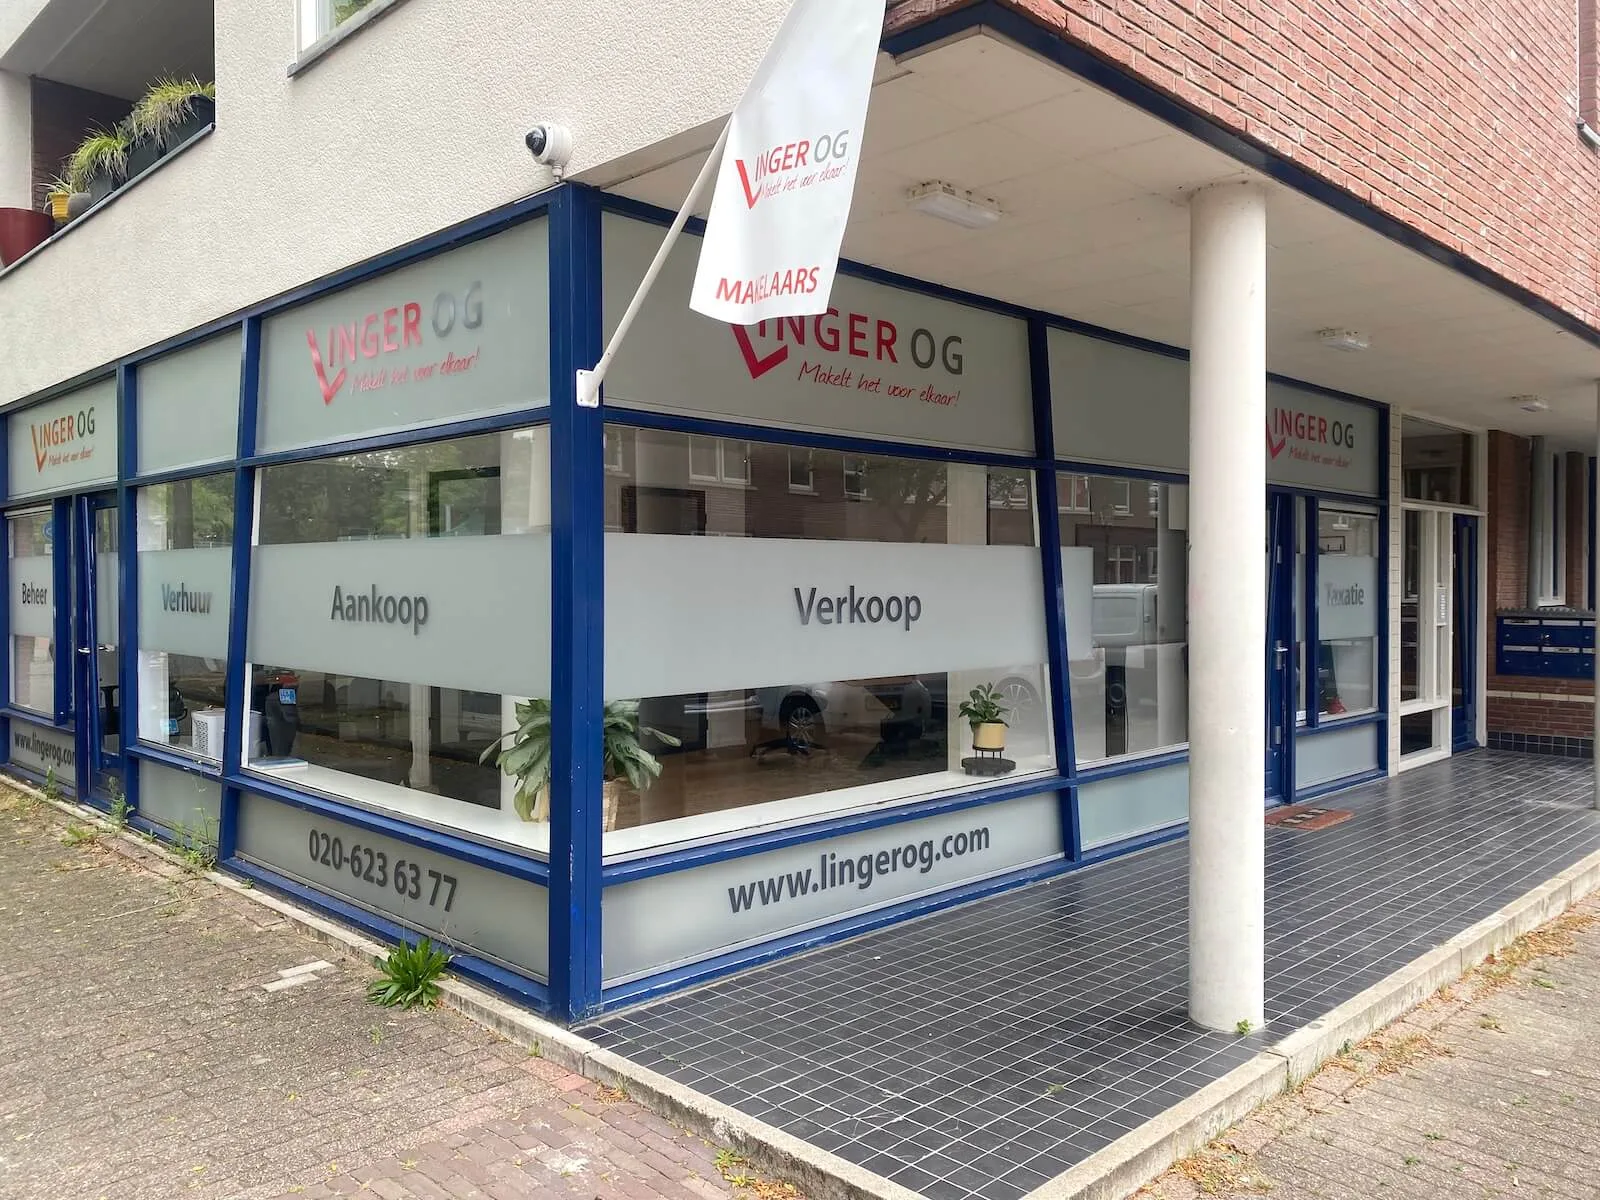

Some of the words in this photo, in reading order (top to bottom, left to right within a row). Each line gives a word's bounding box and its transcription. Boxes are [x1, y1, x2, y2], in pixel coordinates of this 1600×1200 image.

[814, 129, 850, 163] OG
[715, 266, 820, 305] MAKELAARS
[432, 281, 483, 338] OG
[910, 328, 963, 375] OG
[798, 361, 852, 389] Makelt
[857, 374, 881, 393] het
[887, 383, 916, 399] voor
[919, 384, 960, 407] elkaar!
[77, 406, 95, 438] OG
[1332, 421, 1354, 448] OG
[22, 582, 48, 606] Beheer
[161, 582, 213, 614] Verhuur
[331, 583, 429, 635] Aankoop
[794, 585, 922, 632] Verkoop
[1324, 582, 1365, 607] Taxatie
[309, 829, 388, 888] 020-623
[394, 860, 421, 901] 63
[428, 868, 458, 913] 77
[728, 826, 990, 914] www.lingerog.com
